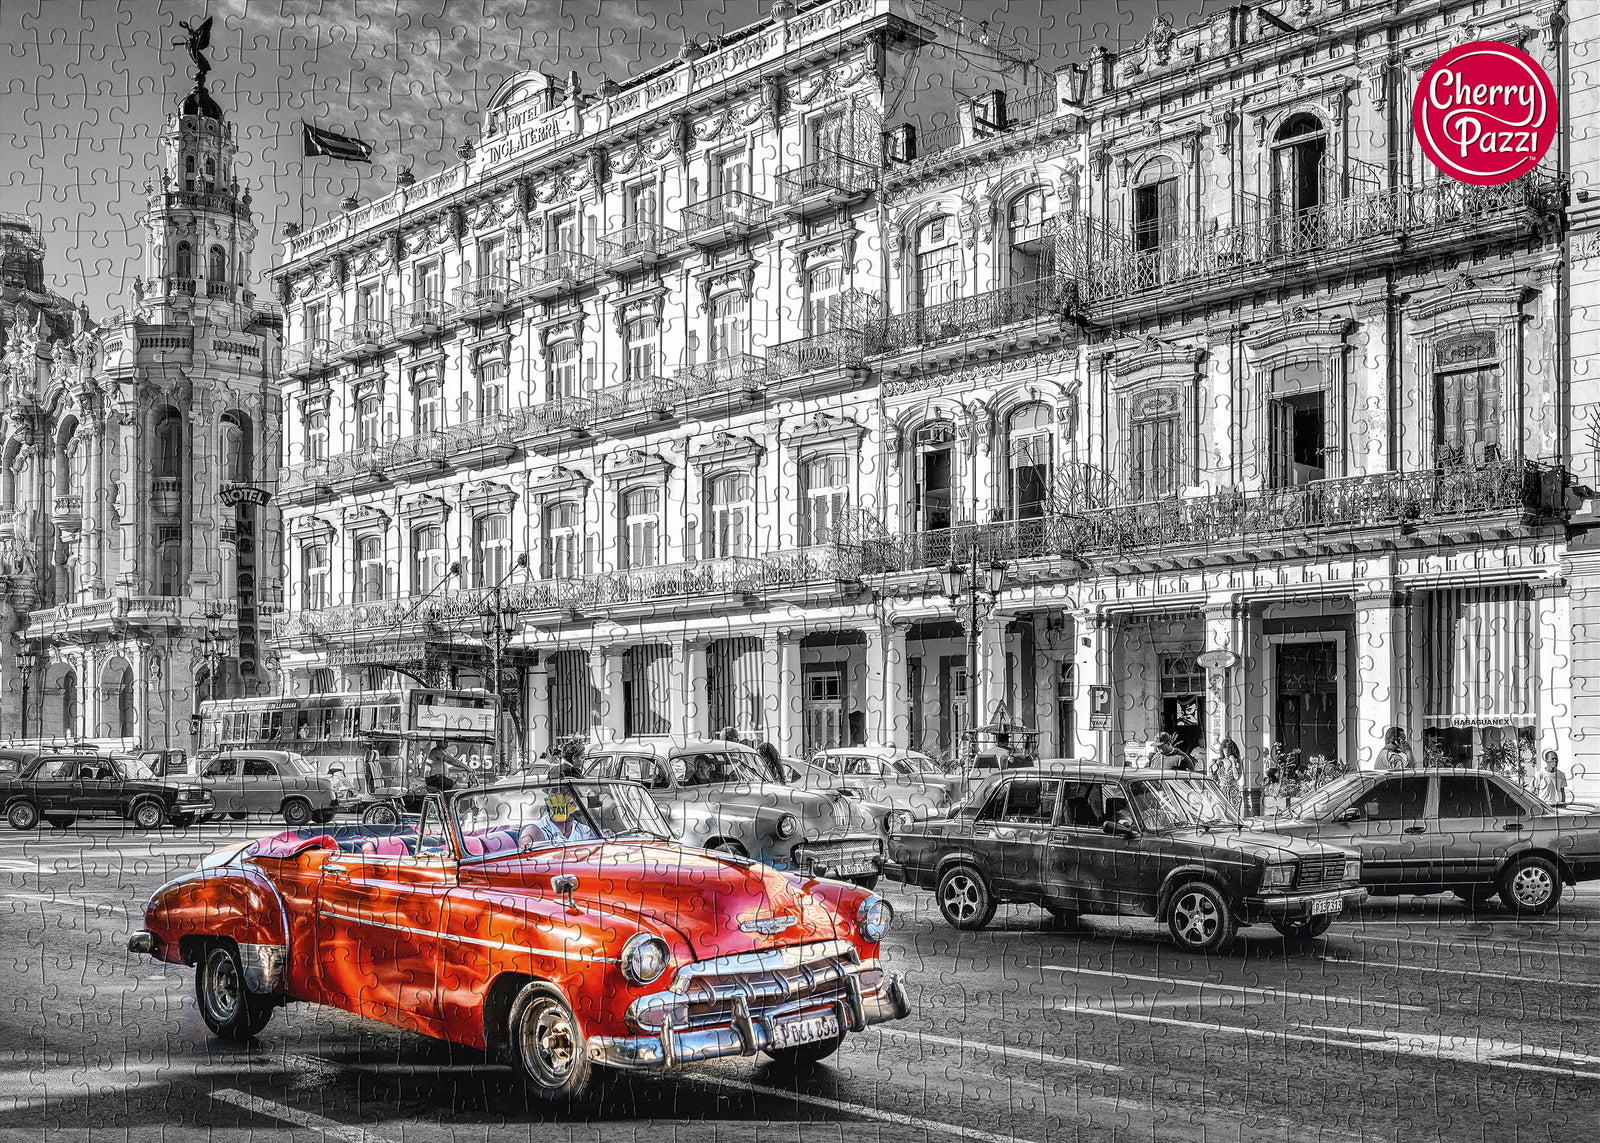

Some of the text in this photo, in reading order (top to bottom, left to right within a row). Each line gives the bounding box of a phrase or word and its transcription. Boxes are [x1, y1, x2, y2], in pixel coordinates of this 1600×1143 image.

[507, 105, 539, 131] HOTEL
[220, 488, 266, 505] HOTEL
[1095, 690, 1109, 711] P
[1453, 718, 1510, 726] HABAGUANEX
[552, 805, 568, 816] TAXI
